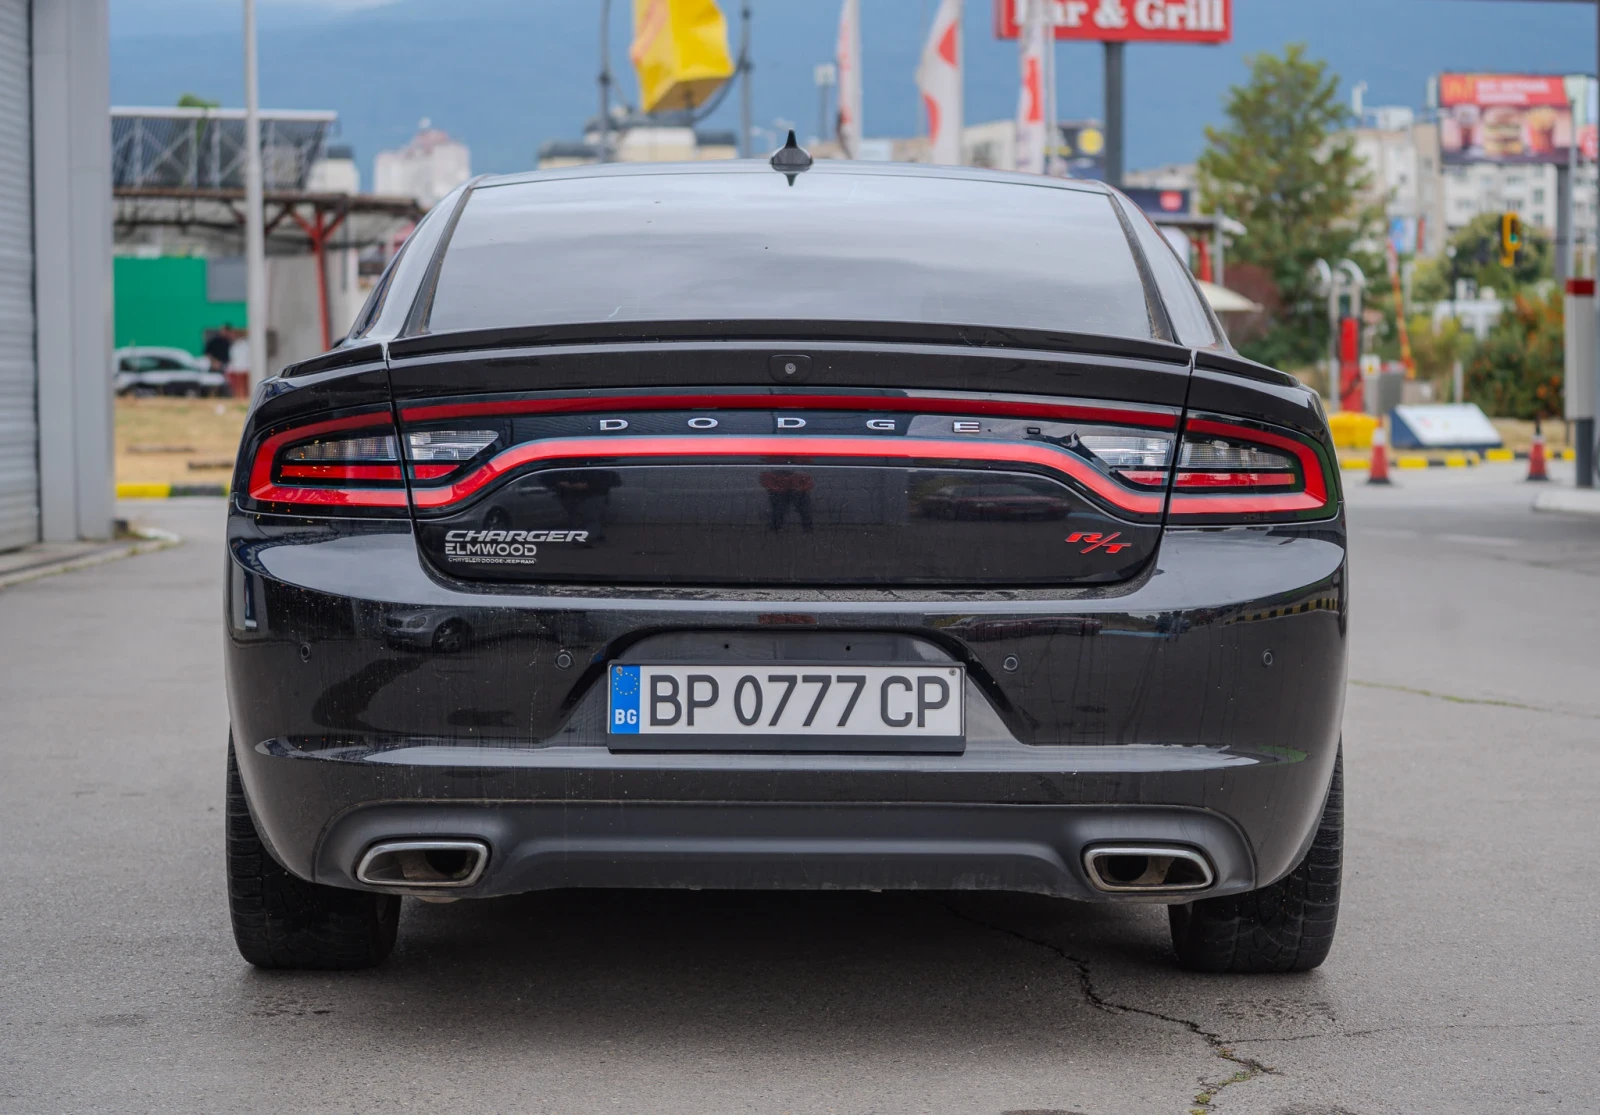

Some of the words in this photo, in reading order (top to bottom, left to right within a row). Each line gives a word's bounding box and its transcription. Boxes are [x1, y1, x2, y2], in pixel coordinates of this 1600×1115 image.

[1093, 0, 1128, 29] &
[1134, 0, 1226, 32] Grill
[599, 417, 980, 433] DODGE
[445, 530, 589, 542] CHARGER
[1065, 531, 1132, 554] R/T
[445, 543, 537, 556] ELMWOOD
[649, 674, 719, 726] BP
[734, 674, 866, 727] 0777
[880, 675, 950, 728] CP
[615, 709, 637, 725] BG
